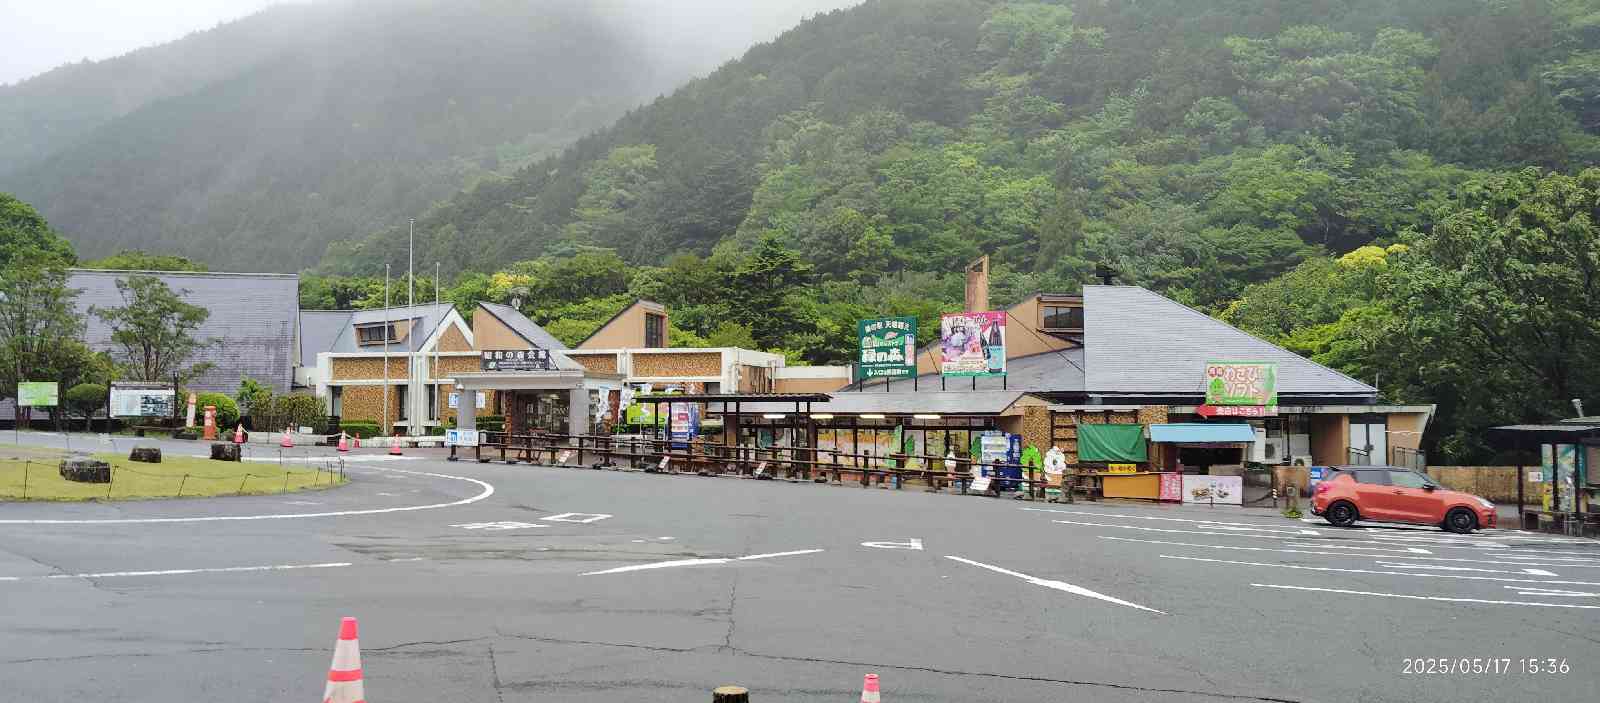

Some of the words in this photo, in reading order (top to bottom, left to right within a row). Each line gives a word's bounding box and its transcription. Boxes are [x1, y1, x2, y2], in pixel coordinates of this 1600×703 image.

[1223, 366, 1258, 382] わさび
[1224, 383, 1260, 399] ソフト
